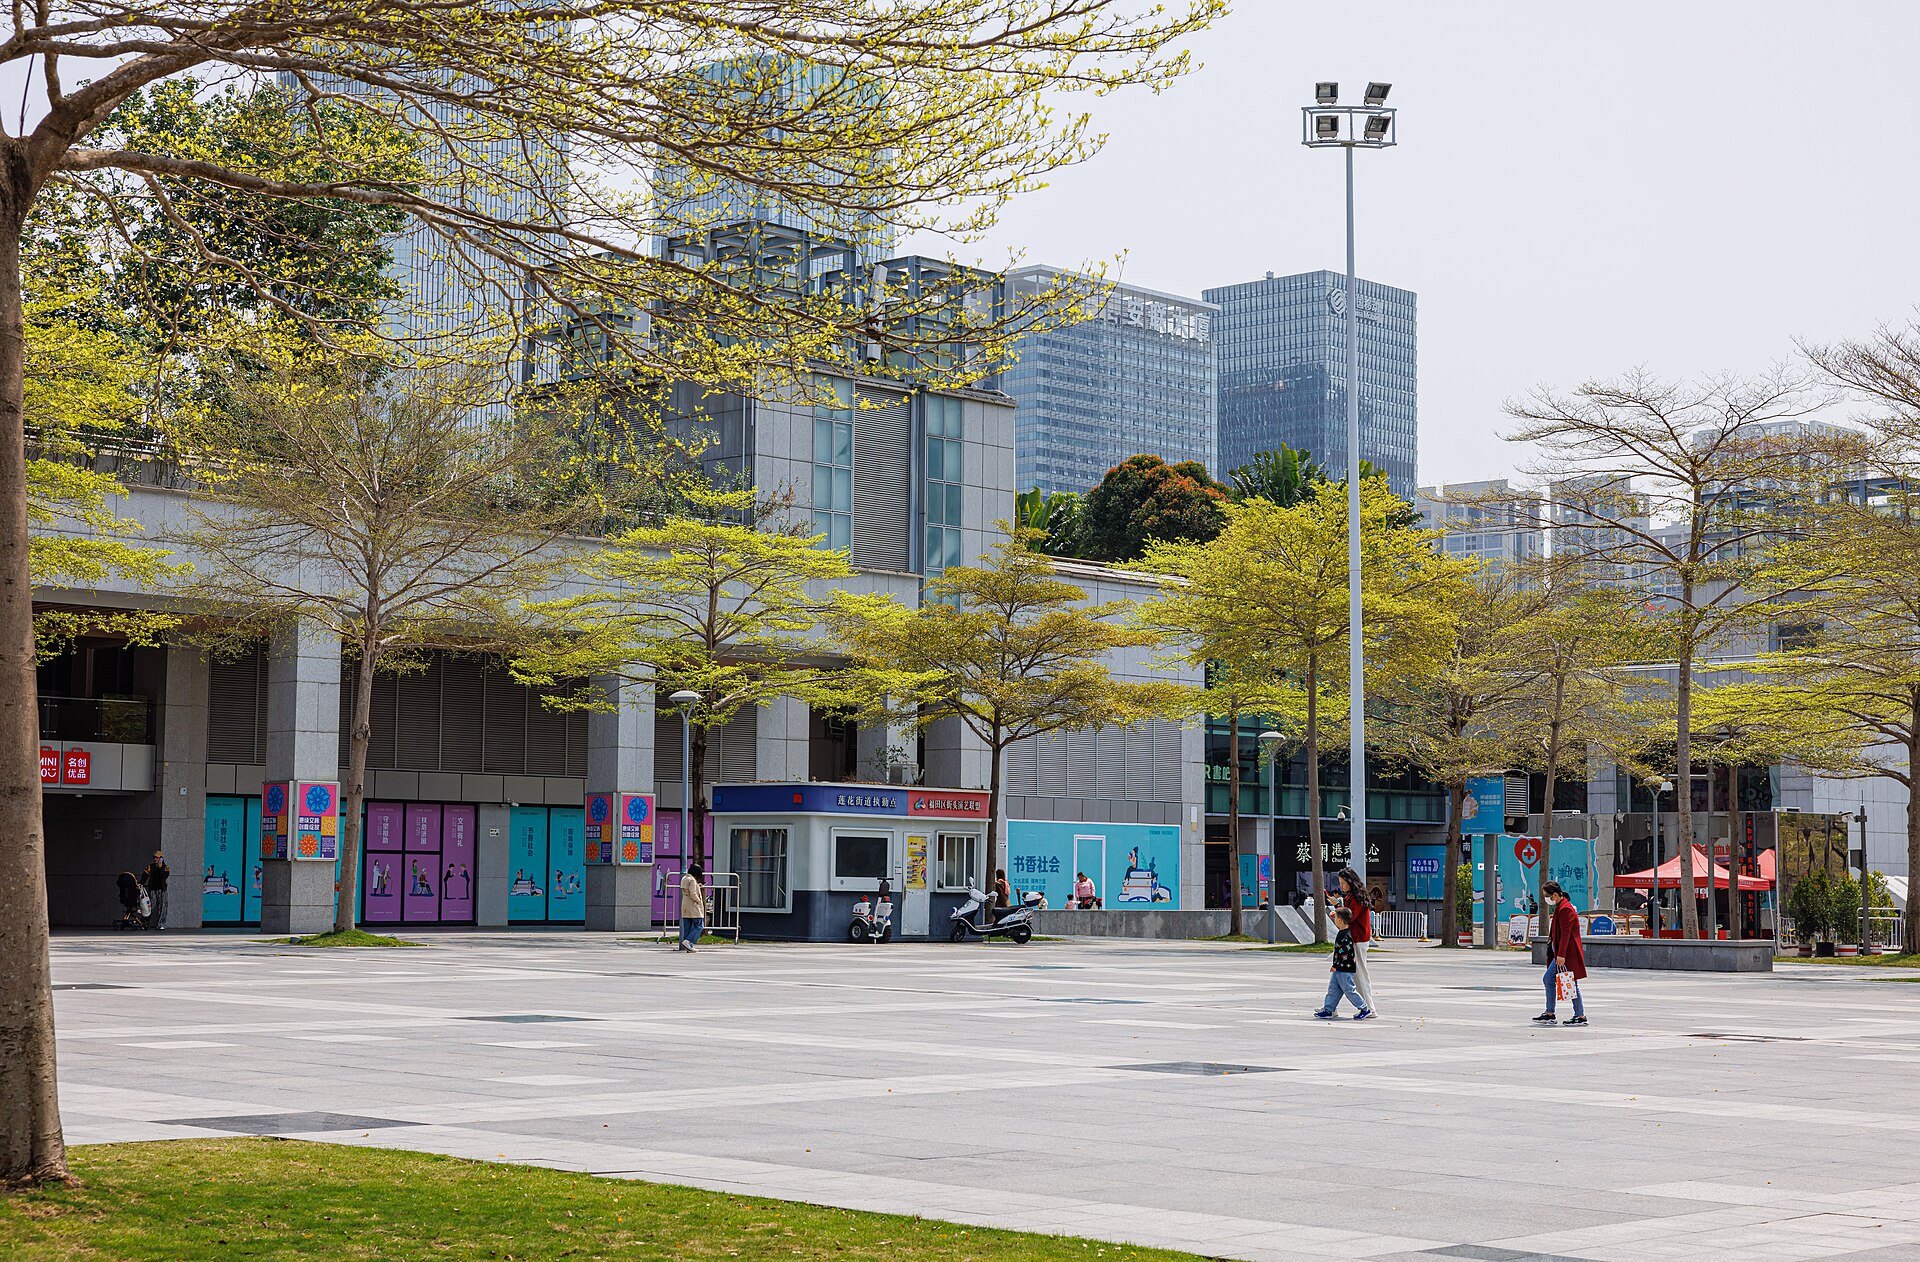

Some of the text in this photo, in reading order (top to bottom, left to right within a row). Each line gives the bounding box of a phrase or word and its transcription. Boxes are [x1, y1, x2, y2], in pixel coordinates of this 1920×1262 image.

[1127, 297, 1211, 344] 安联大厦
[68, 757, 87, 768] 名创
[68, 768, 87, 779] 优品
[837, 794, 897, 808] 莲花街道执勤点
[1013, 855, 1061, 873] 书香社会
